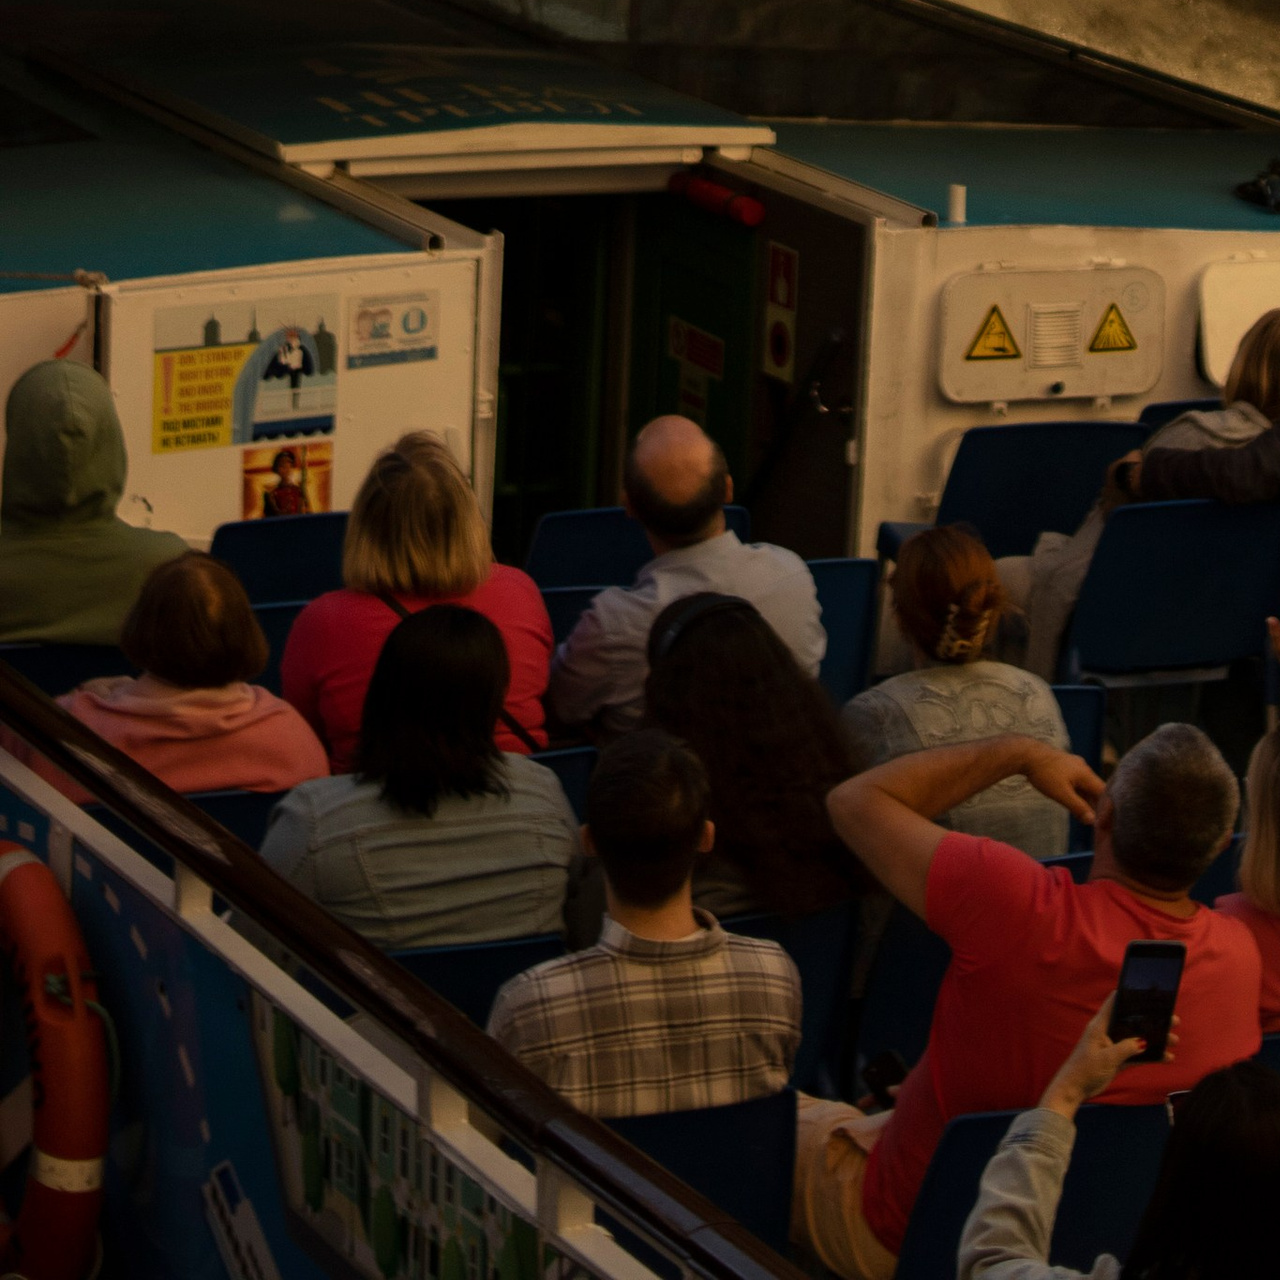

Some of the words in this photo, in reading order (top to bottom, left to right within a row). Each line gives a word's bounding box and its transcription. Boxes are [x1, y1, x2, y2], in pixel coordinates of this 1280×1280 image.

[179, 387, 195, 397] AND
[195, 399, 231, 411] BRIDGES
[162, 420, 179, 431] ПОД
[182, 416, 222, 429] МОСТАМИ
[162, 438, 171, 447] НЕ
